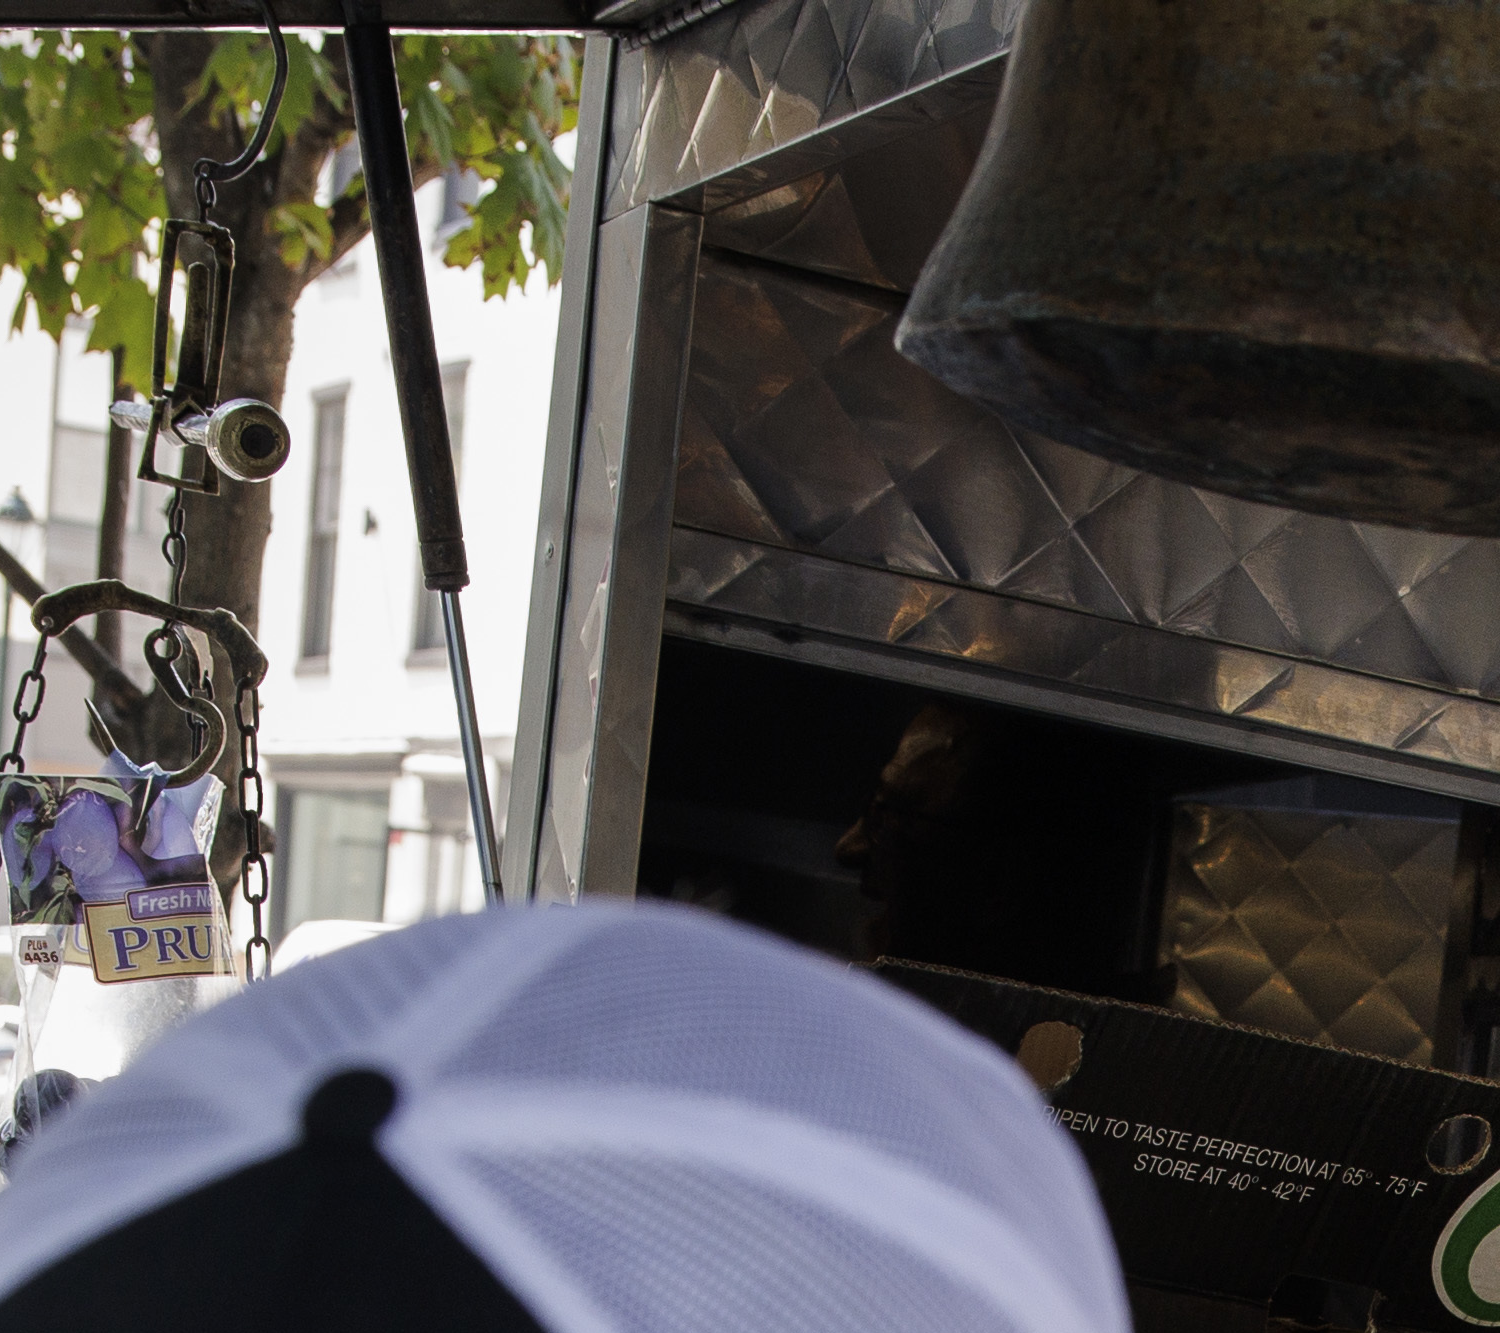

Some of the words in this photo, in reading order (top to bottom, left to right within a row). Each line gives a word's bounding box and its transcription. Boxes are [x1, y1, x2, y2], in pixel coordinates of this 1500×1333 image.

[137, 889, 191, 914] Fresh
[24, 951, 59, 963] 4436
[1042, 1105, 1100, 1133] RIPEN
[1103, 1117, 1129, 1139] TO
[1133, 1123, 1192, 1151] TASTE
[1192, 1135, 1316, 1176] PERFECTION
[1314, 1161, 1341, 1180] AT
[1342, 1167, 1373, 1187] 65°
[1385, 1175, 1428, 1198] 75°F
[1133, 1153, 1201, 1182] STORE
[1199, 1166, 1227, 1186] AT
[1228, 1172, 1260, 1192] 40°
[1271, 1181, 1315, 1203] 42°F
